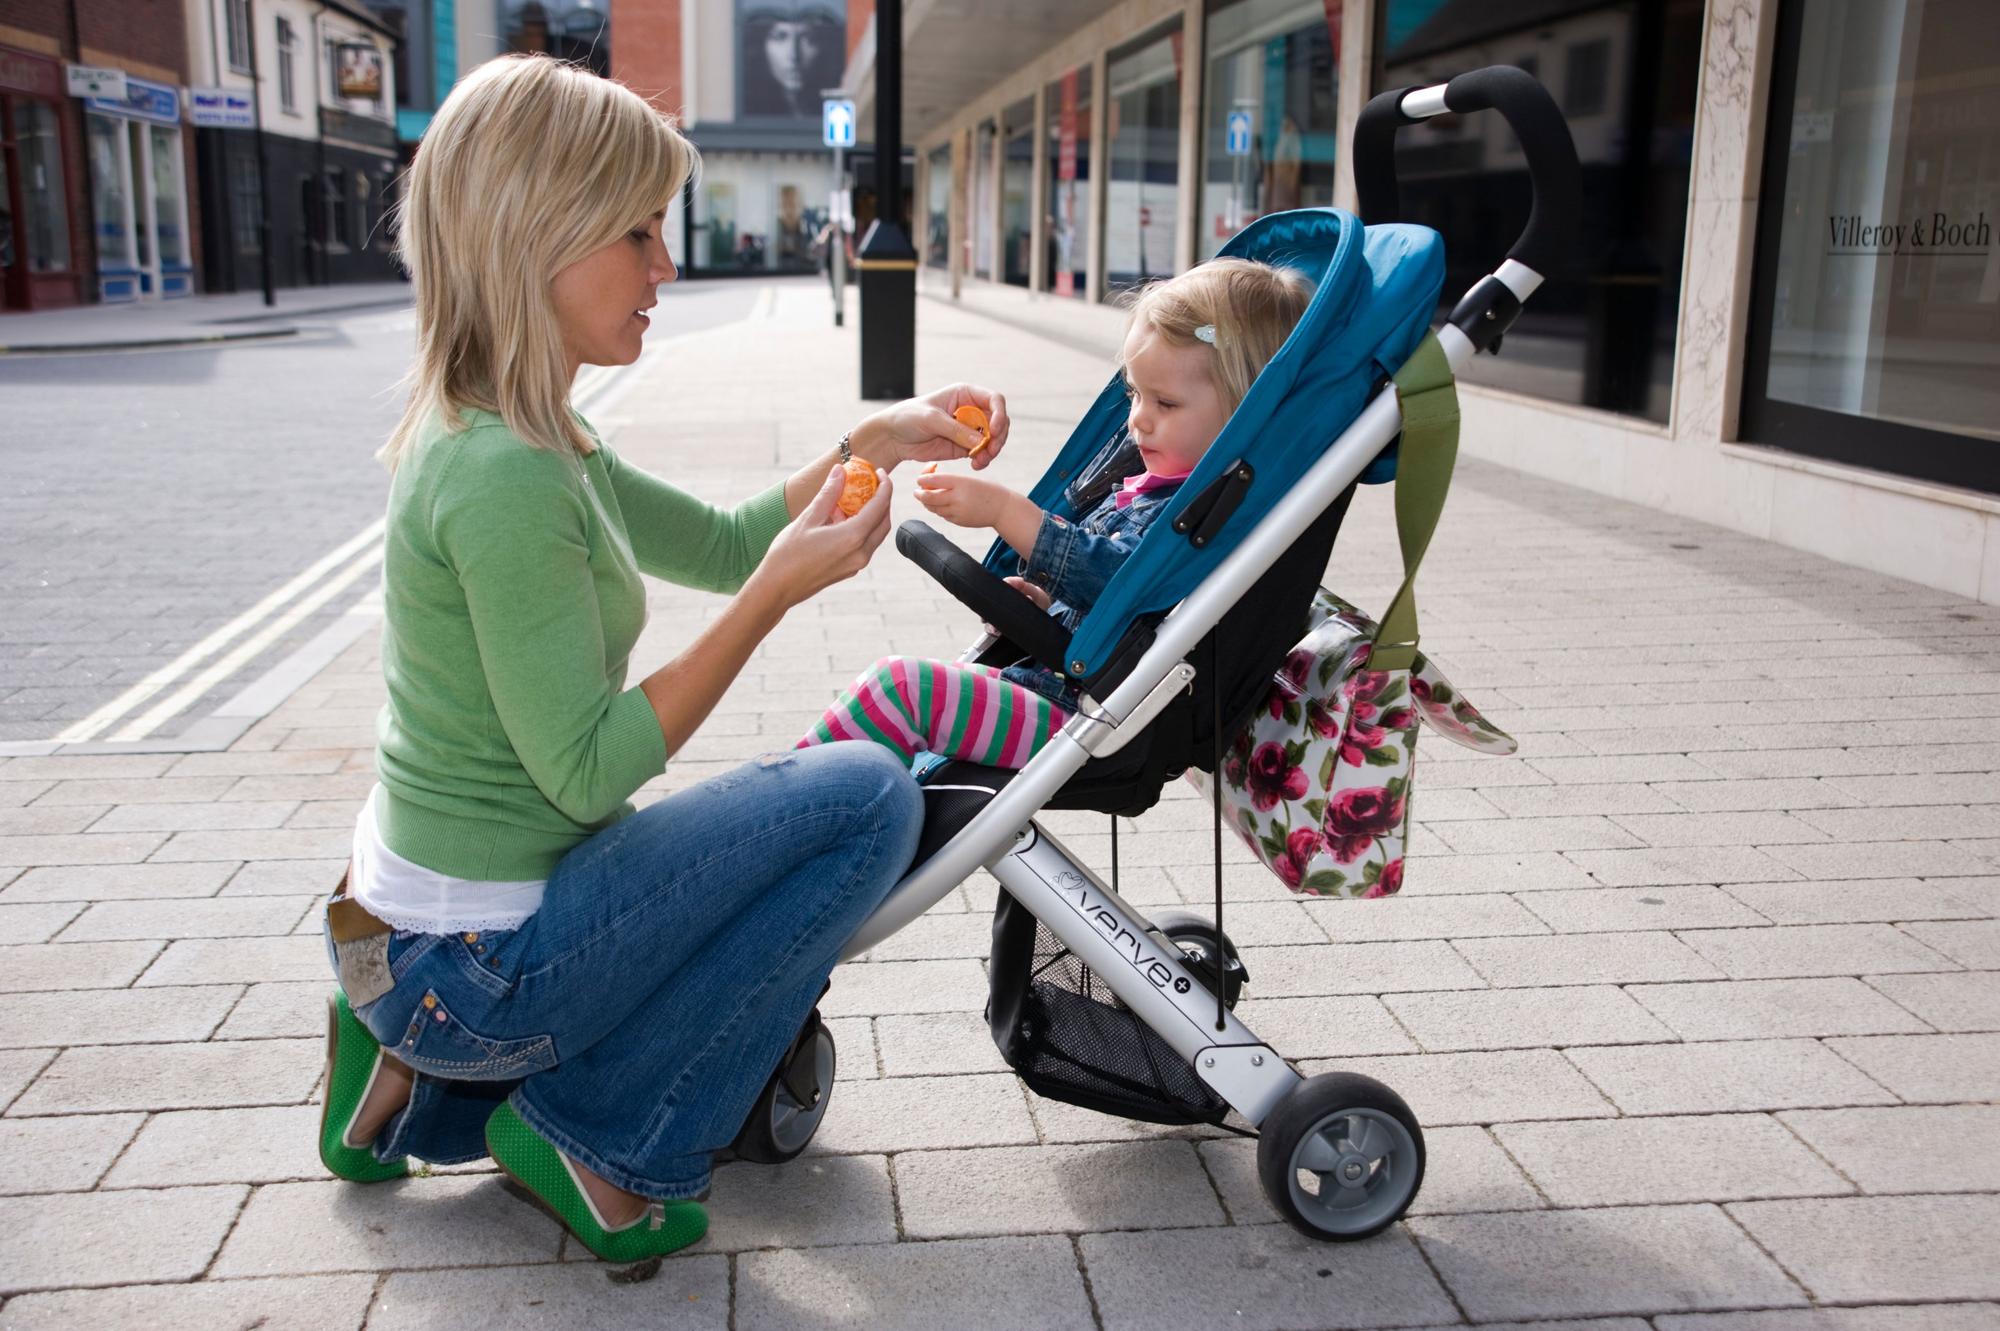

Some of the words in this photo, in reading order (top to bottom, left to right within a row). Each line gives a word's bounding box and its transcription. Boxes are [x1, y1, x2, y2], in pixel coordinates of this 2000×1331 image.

[1829, 215, 1907, 256] Villeroy
[1911, 218, 1925, 247] &
[1931, 211, 1991, 247] Boch
